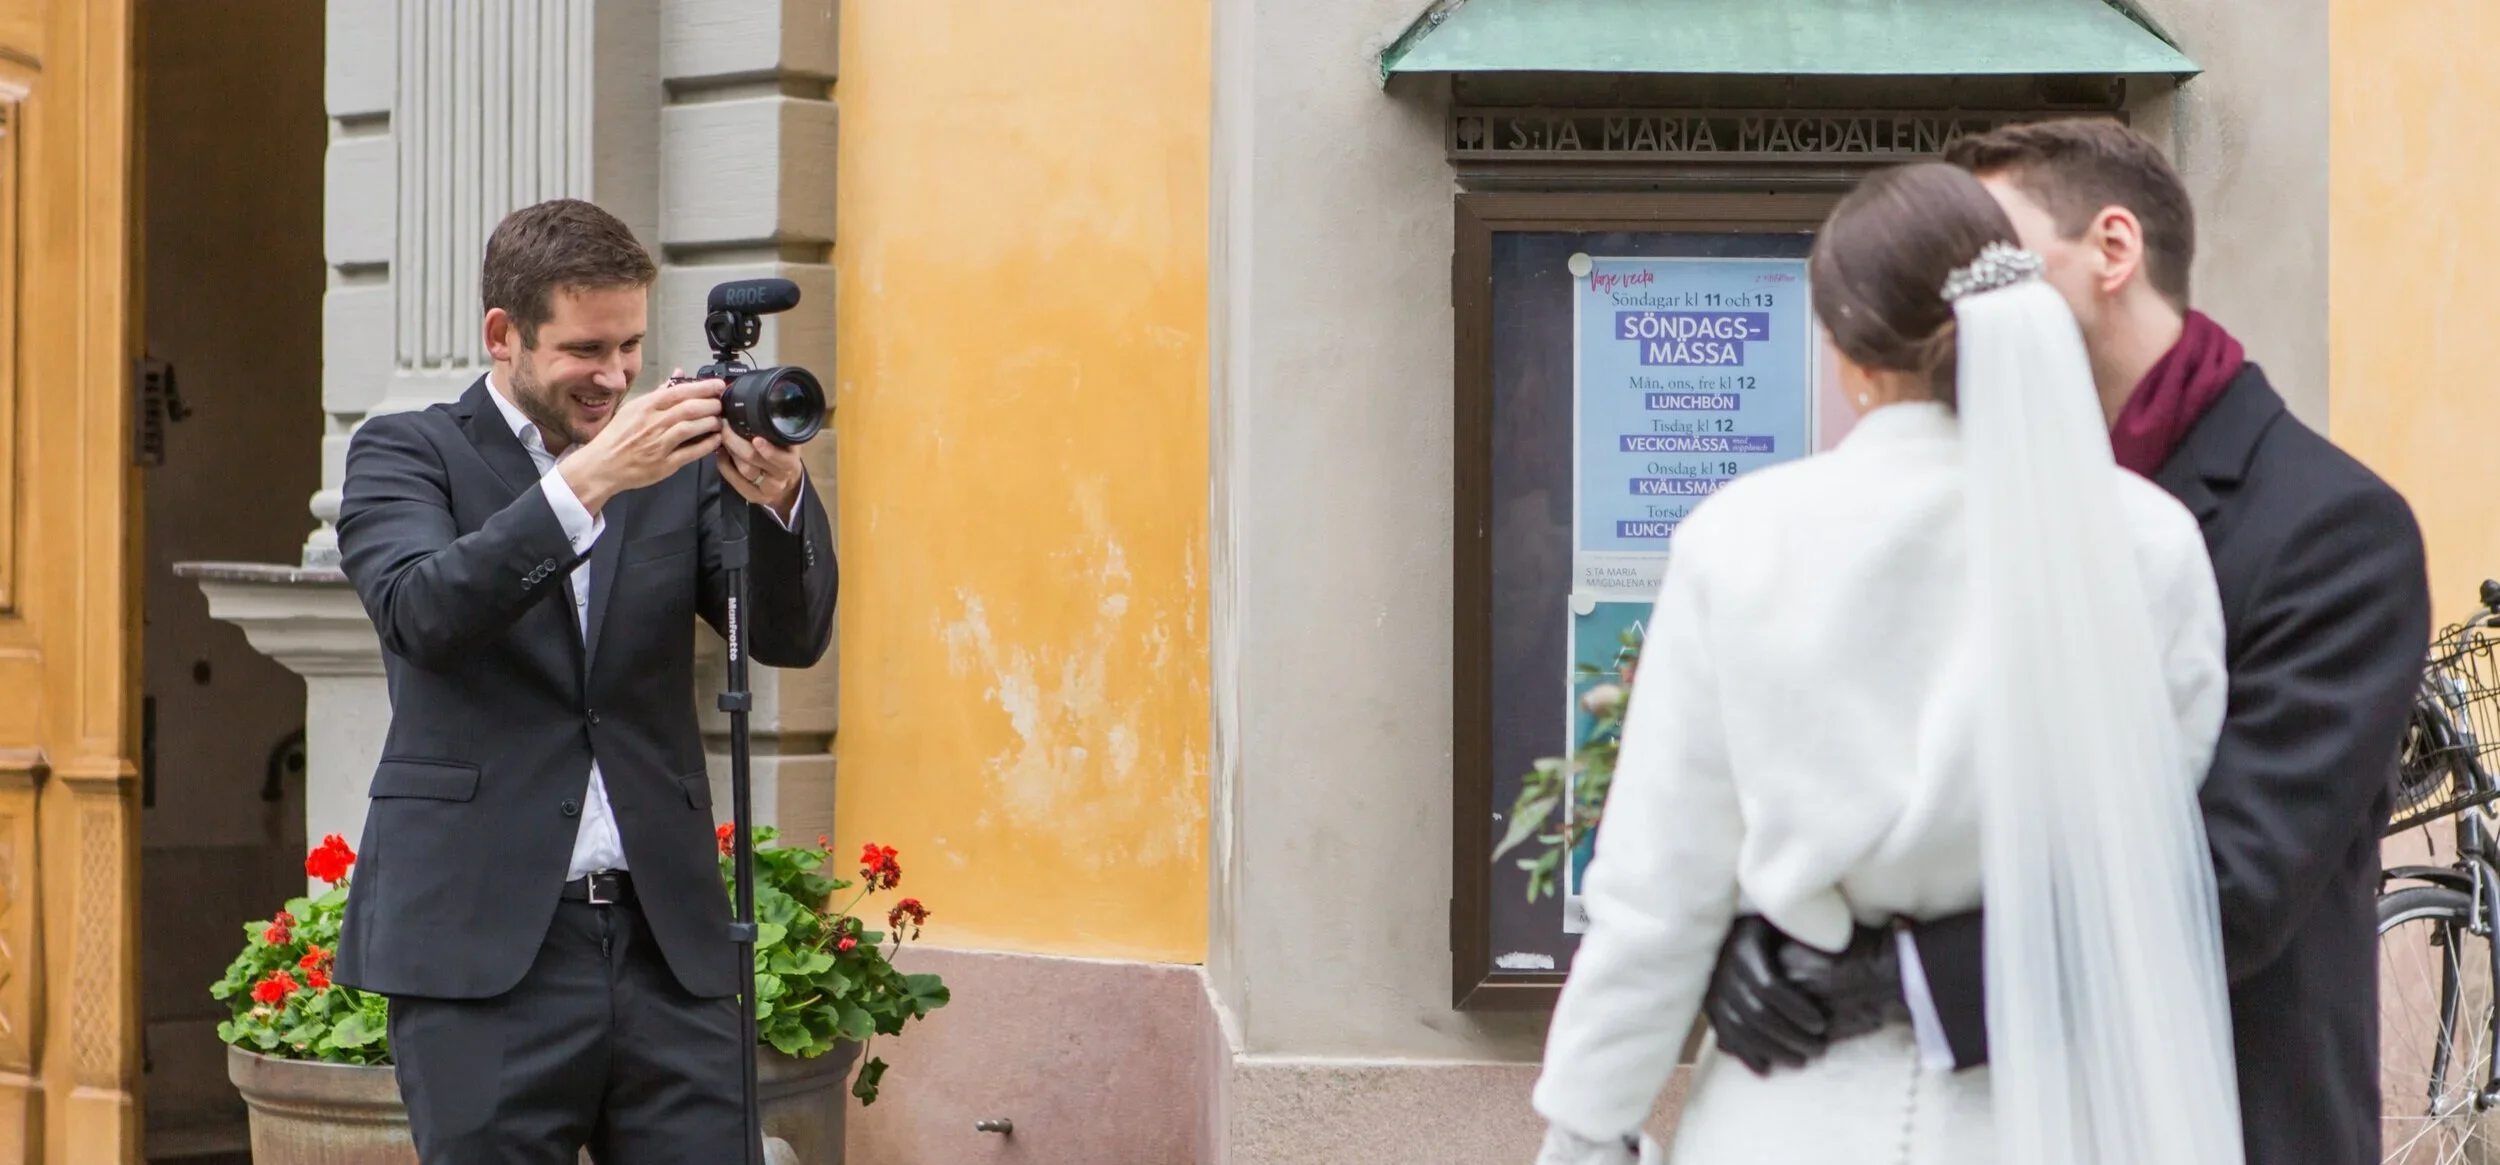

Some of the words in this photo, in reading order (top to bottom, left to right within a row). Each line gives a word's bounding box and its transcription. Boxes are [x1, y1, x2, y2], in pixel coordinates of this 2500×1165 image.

[1603, 116, 1717, 151] MARIA
[1738, 116, 1965, 152] MAGDALENA
[1622, 268, 1654, 288] vecka
[1611, 291, 1680, 308] Söndagar
[1685, 291, 1698, 305] kl
[1704, 293, 1721, 306] 11
[1724, 292, 1750, 307] och
[1754, 293, 1774, 307] 13
[1623, 312, 1761, 338] SÖNDAGS-
[1648, 337, 1738, 364] MÄSSA
[1629, 375, 1664, 391] Mån,
[1667, 379, 1694, 391] ons,
[1698, 375, 1716, 389] fre
[1719, 375, 1732, 389] kl
[1737, 376, 1756, 389] 12
[1651, 393, 1734, 409] LUNCHBÖN
[1651, 419, 1693, 436] Tisdag
[1696, 418, 1709, 432] kl
[1714, 419, 1734, 432] 12
[1626, 434, 1729, 451] VECKOMÄSSA
[1647, 461, 1697, 477] Onsdag
[1701, 461, 1714, 475] kl
[1718, 462, 1737, 475] 18
[1646, 504, 1690, 518] Torsda
[1625, 523, 1675, 537] LUNCH
[1606, 567, 1638, 577] MARIA
[1585, 578, 1645, 588] MAGDALENA
[728, 597, 738, 661] Manfrotto
